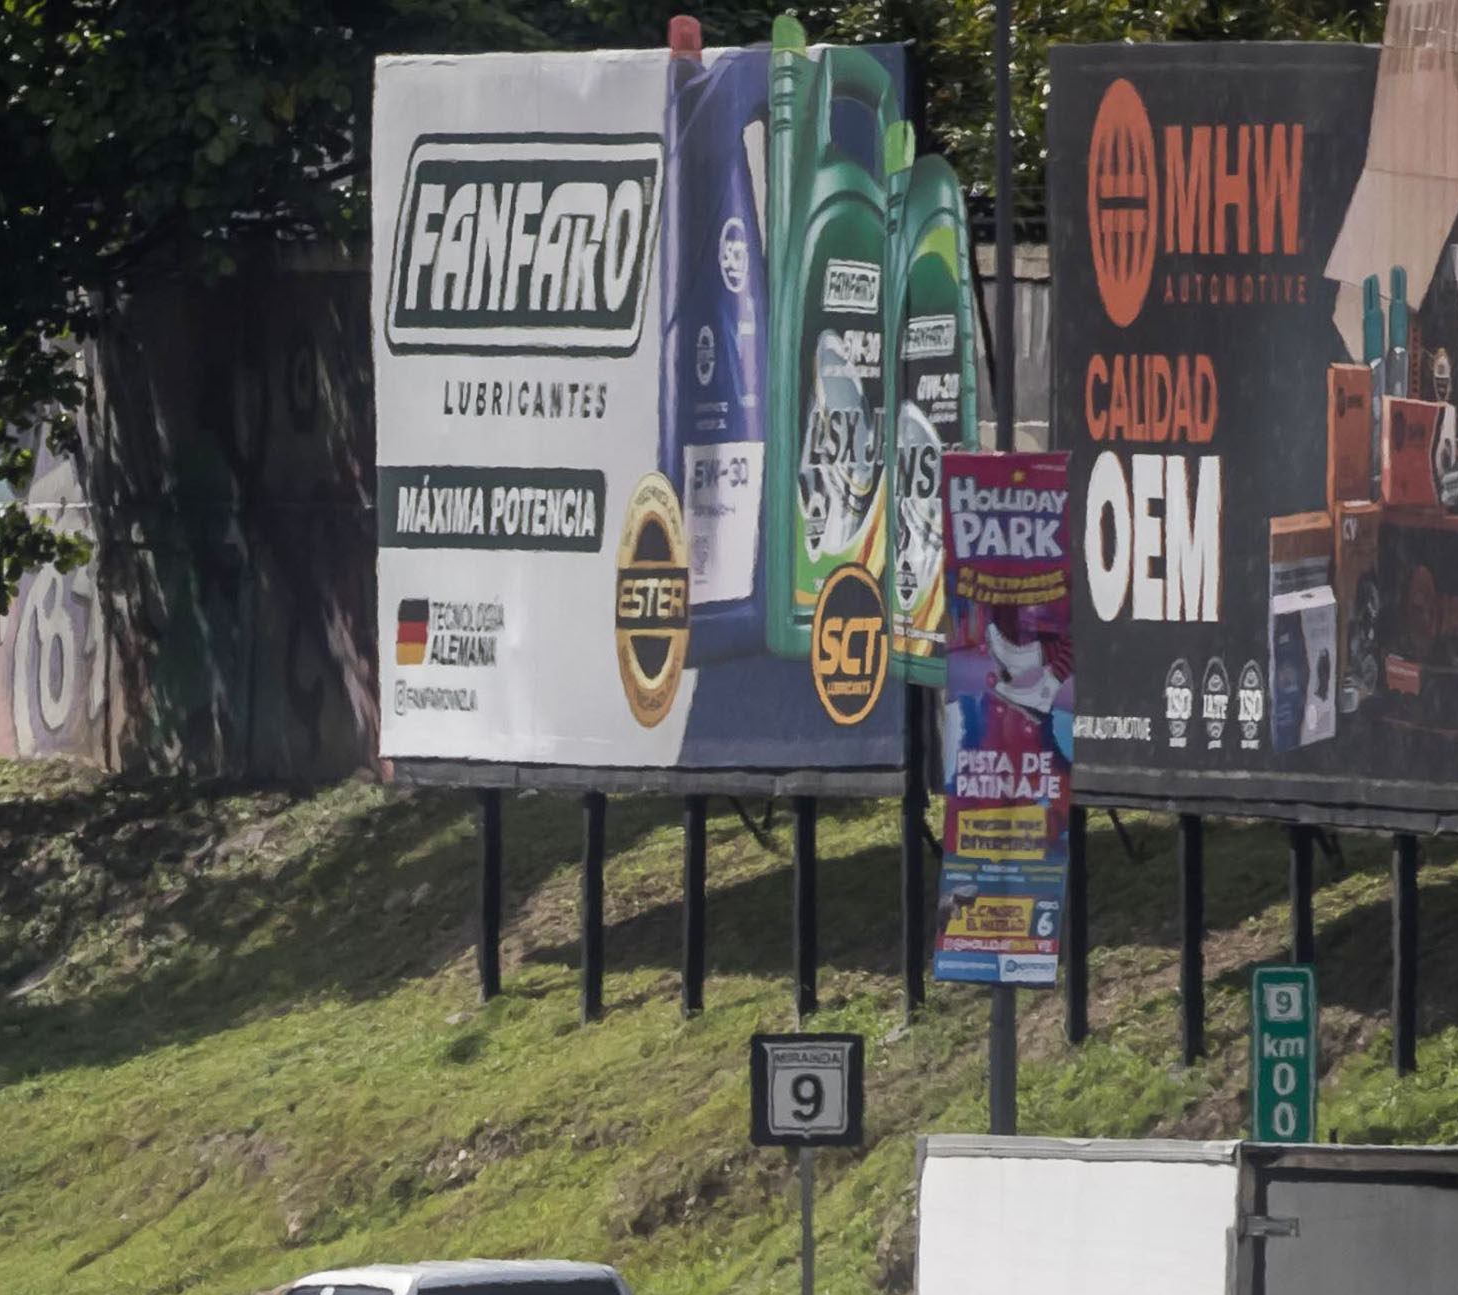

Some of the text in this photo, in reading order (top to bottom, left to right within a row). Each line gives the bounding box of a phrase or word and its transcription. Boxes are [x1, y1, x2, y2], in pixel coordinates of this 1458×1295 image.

[1164, 123, 1304, 255] MHW
[407, 179, 643, 313] FANFARO
[1164, 274, 1307, 305] AUTOMOTIVE
[444, 379, 609, 420] LUBRICANTES
[1085, 353, 1218, 443] CALIDAD
[396, 475, 596, 540] MÁXIMA POTENCIA
[949, 476, 1068, 515] HOLLIDAY
[950, 513, 1066, 560] PARK
[1084, 450, 1223, 623] OEM
[618, 576, 687, 620] ESTER
[821, 616, 882, 674] SCT
[1166, 686, 1192, 720] ISO
[1238, 689, 1264, 721] ISO
[957, 750, 1054, 775] PISTA DE
[956, 774, 1062, 799] PATINAJE
[1037, 911, 1054, 937] 6
[1274, 989, 1292, 1015] 9
[772, 1050, 843, 1067] MIRANDA
[1262, 1032, 1306, 1059] km
[789, 1071, 826, 1122] 9
[1271, 1062, 1296, 1097] 0
[1271, 1102, 1296, 1137] 0
